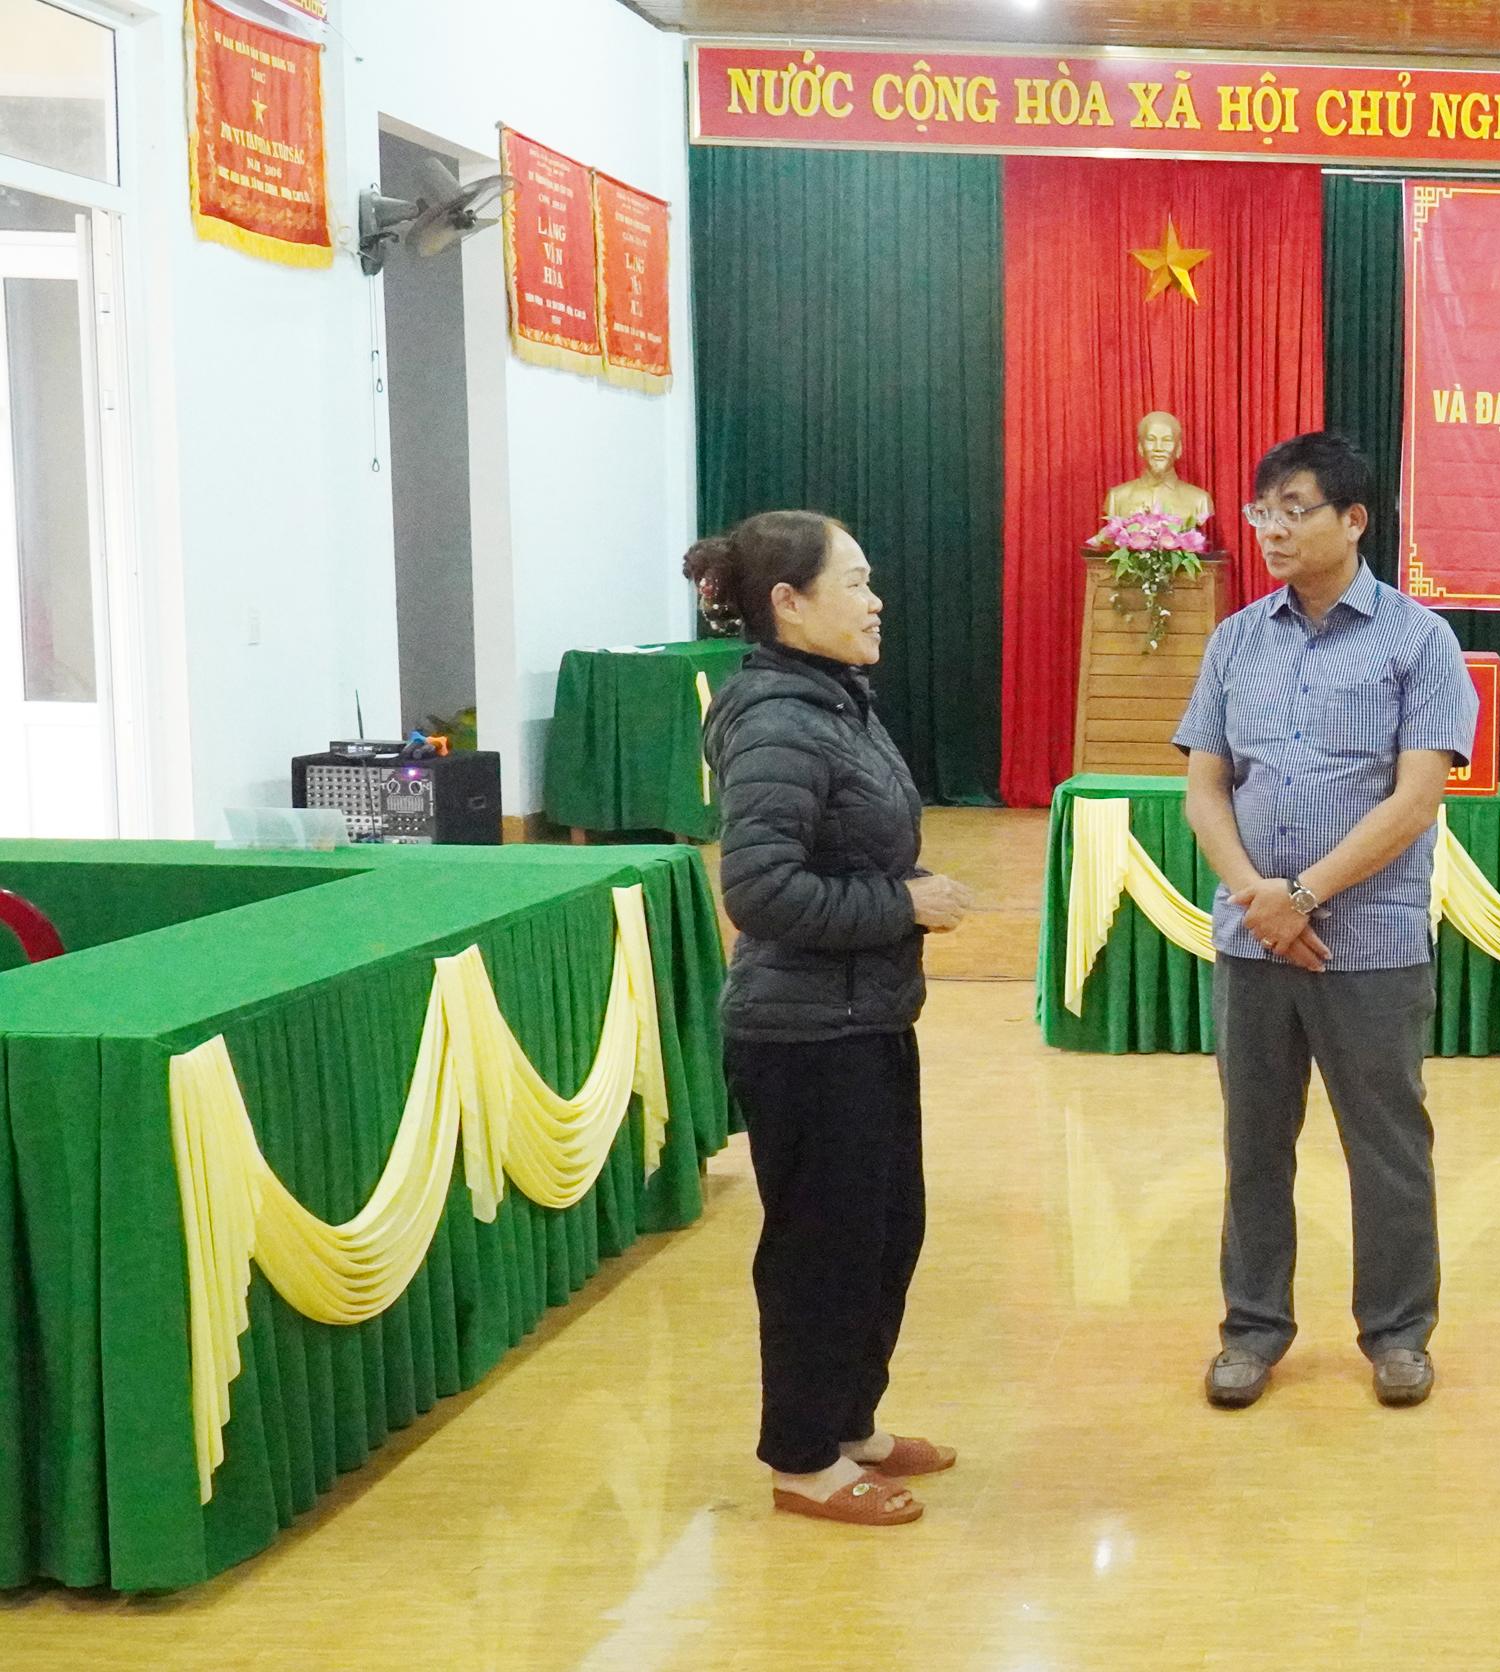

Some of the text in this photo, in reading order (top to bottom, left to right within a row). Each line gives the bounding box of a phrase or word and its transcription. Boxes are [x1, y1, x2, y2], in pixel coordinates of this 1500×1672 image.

[727, 49, 851, 117] NƯỚC
[869, 61, 998, 132] CỘNG
[1014, 64, 1114, 126] HÒA
[1128, 70, 1204, 130] XÃ
[1216, 71, 1300, 145] HỘI
[1316, 72, 1416, 137] CHỦ
[1433, 383, 1468, 423] VÀ
